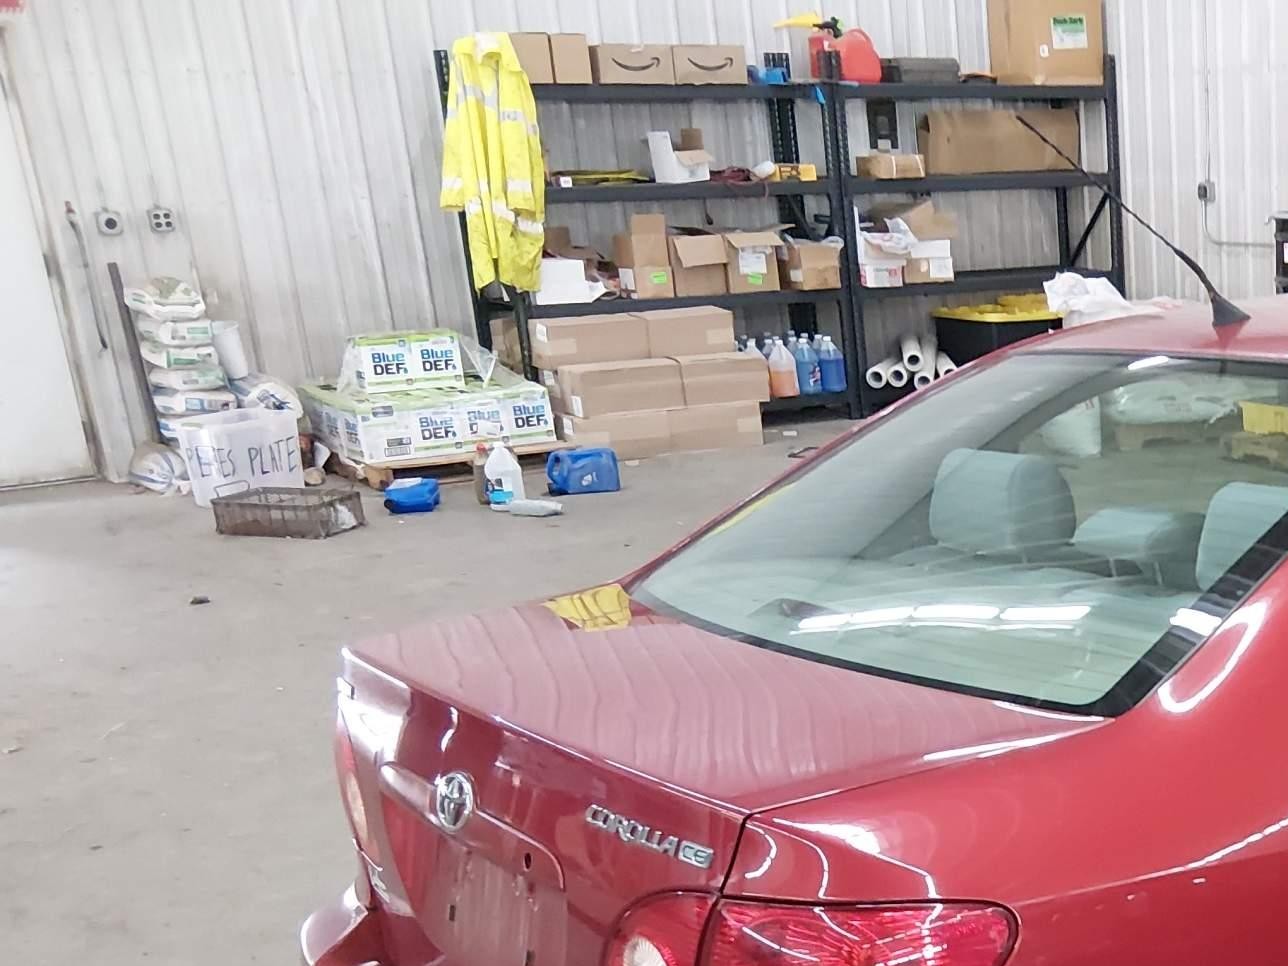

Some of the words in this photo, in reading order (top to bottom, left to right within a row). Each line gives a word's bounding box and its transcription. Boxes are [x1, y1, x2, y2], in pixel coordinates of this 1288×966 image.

[371, 352, 405, 364] Blue
[420, 349, 454, 360] Blue
[373, 362, 406, 376] DEF
[422, 359, 455, 372] DEF
[512, 404, 545, 416] Blue
[418, 415, 453, 428] Blue
[514, 414, 546, 429] DEF
[421, 425, 455, 441] DEF
[585, 804, 679, 857] COROLLA
